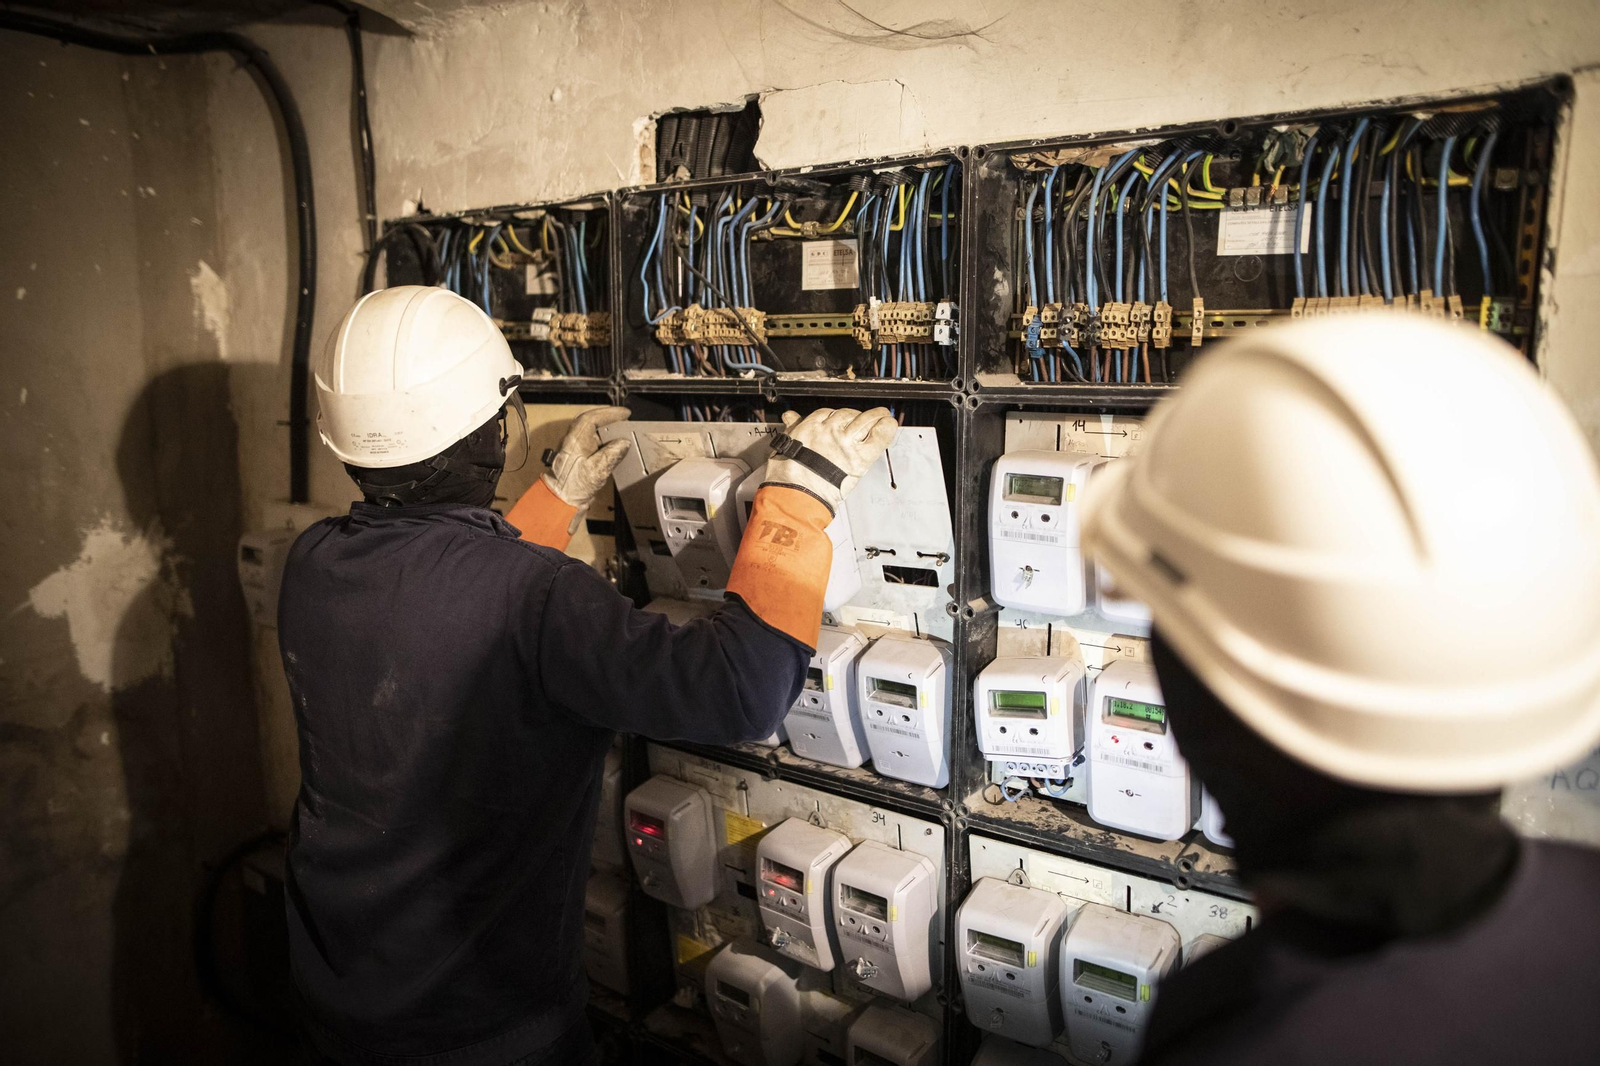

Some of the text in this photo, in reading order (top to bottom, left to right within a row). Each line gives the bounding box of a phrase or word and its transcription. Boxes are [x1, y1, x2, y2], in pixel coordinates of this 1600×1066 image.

[833, 248, 854, 257] ETELSA
[1072, 419, 1086, 432] 14
[759, 520, 798, 547] TB
[871, 811, 886, 826] 34
[1166, 894, 1178, 908] 2
[1208, 904, 1229, 920] 38
